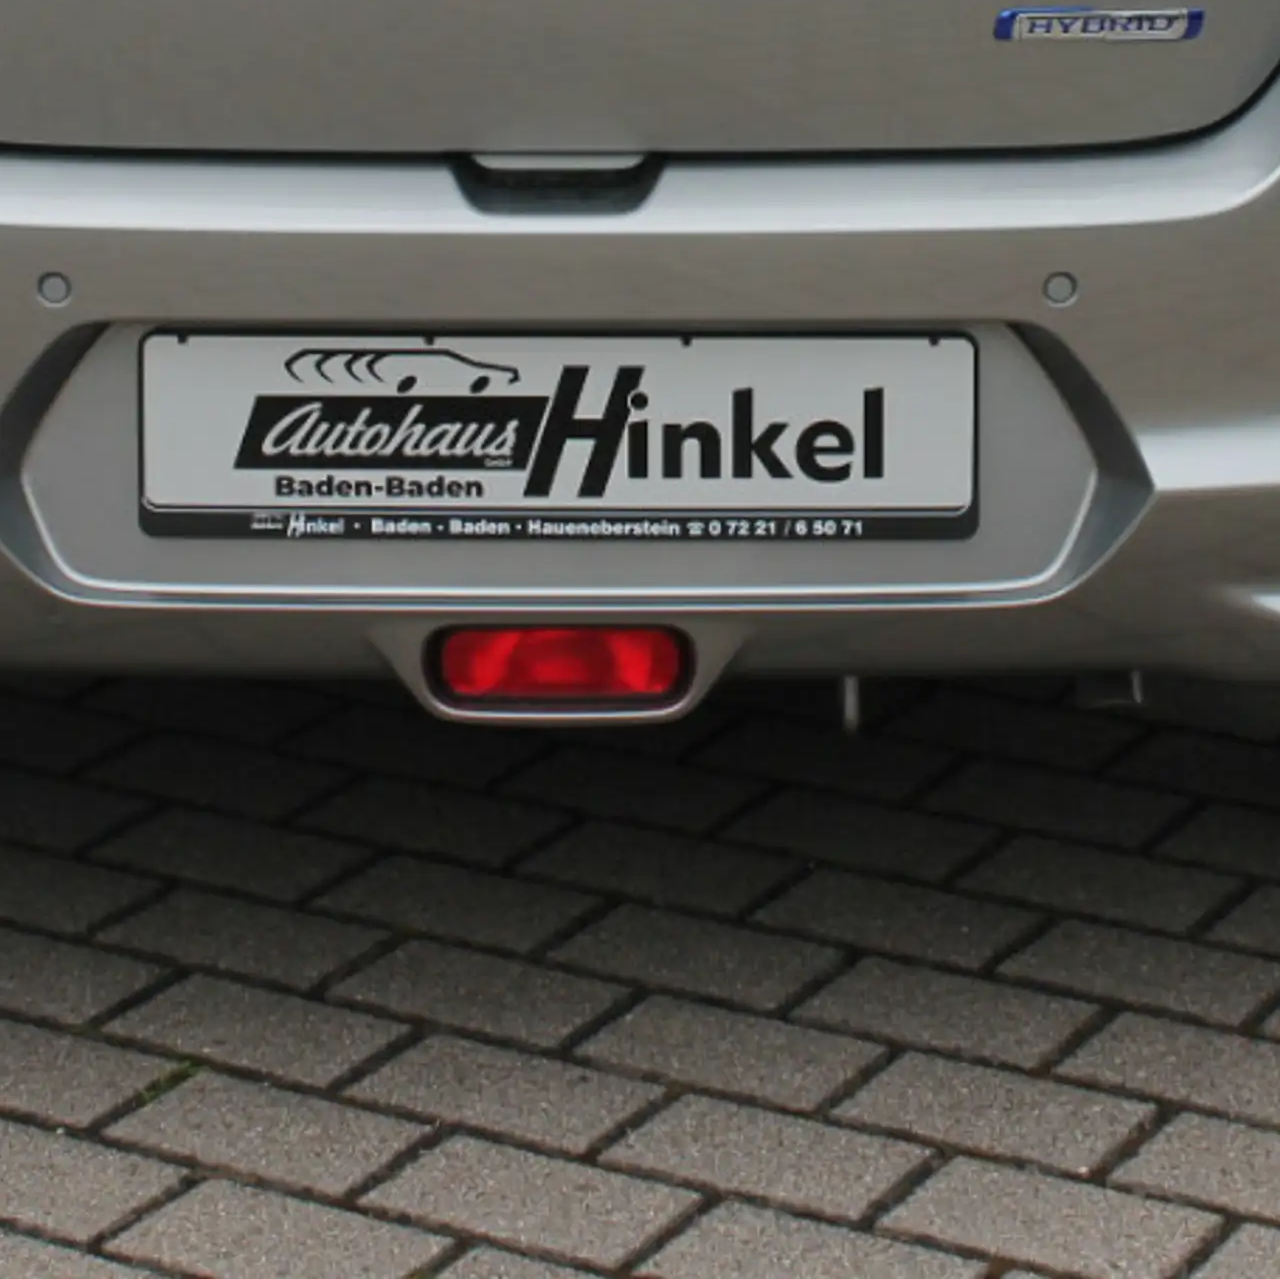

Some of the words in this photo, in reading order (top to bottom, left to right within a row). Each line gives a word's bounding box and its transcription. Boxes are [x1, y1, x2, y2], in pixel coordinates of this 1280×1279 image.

[1026, 13, 1179, 35] HYBRID
[261, 401, 520, 457] Autohaus
[523, 365, 884, 498] Hinkel
[274, 475, 484, 499] Baden-Baden
[371, 518, 432, 535] Baden
[449, 518, 510, 535] Baden
[726, 519, 751, 536] 72
[754, 519, 777, 536] 21
[812, 519, 837, 536] 50
[841, 519, 864, 536] 71
